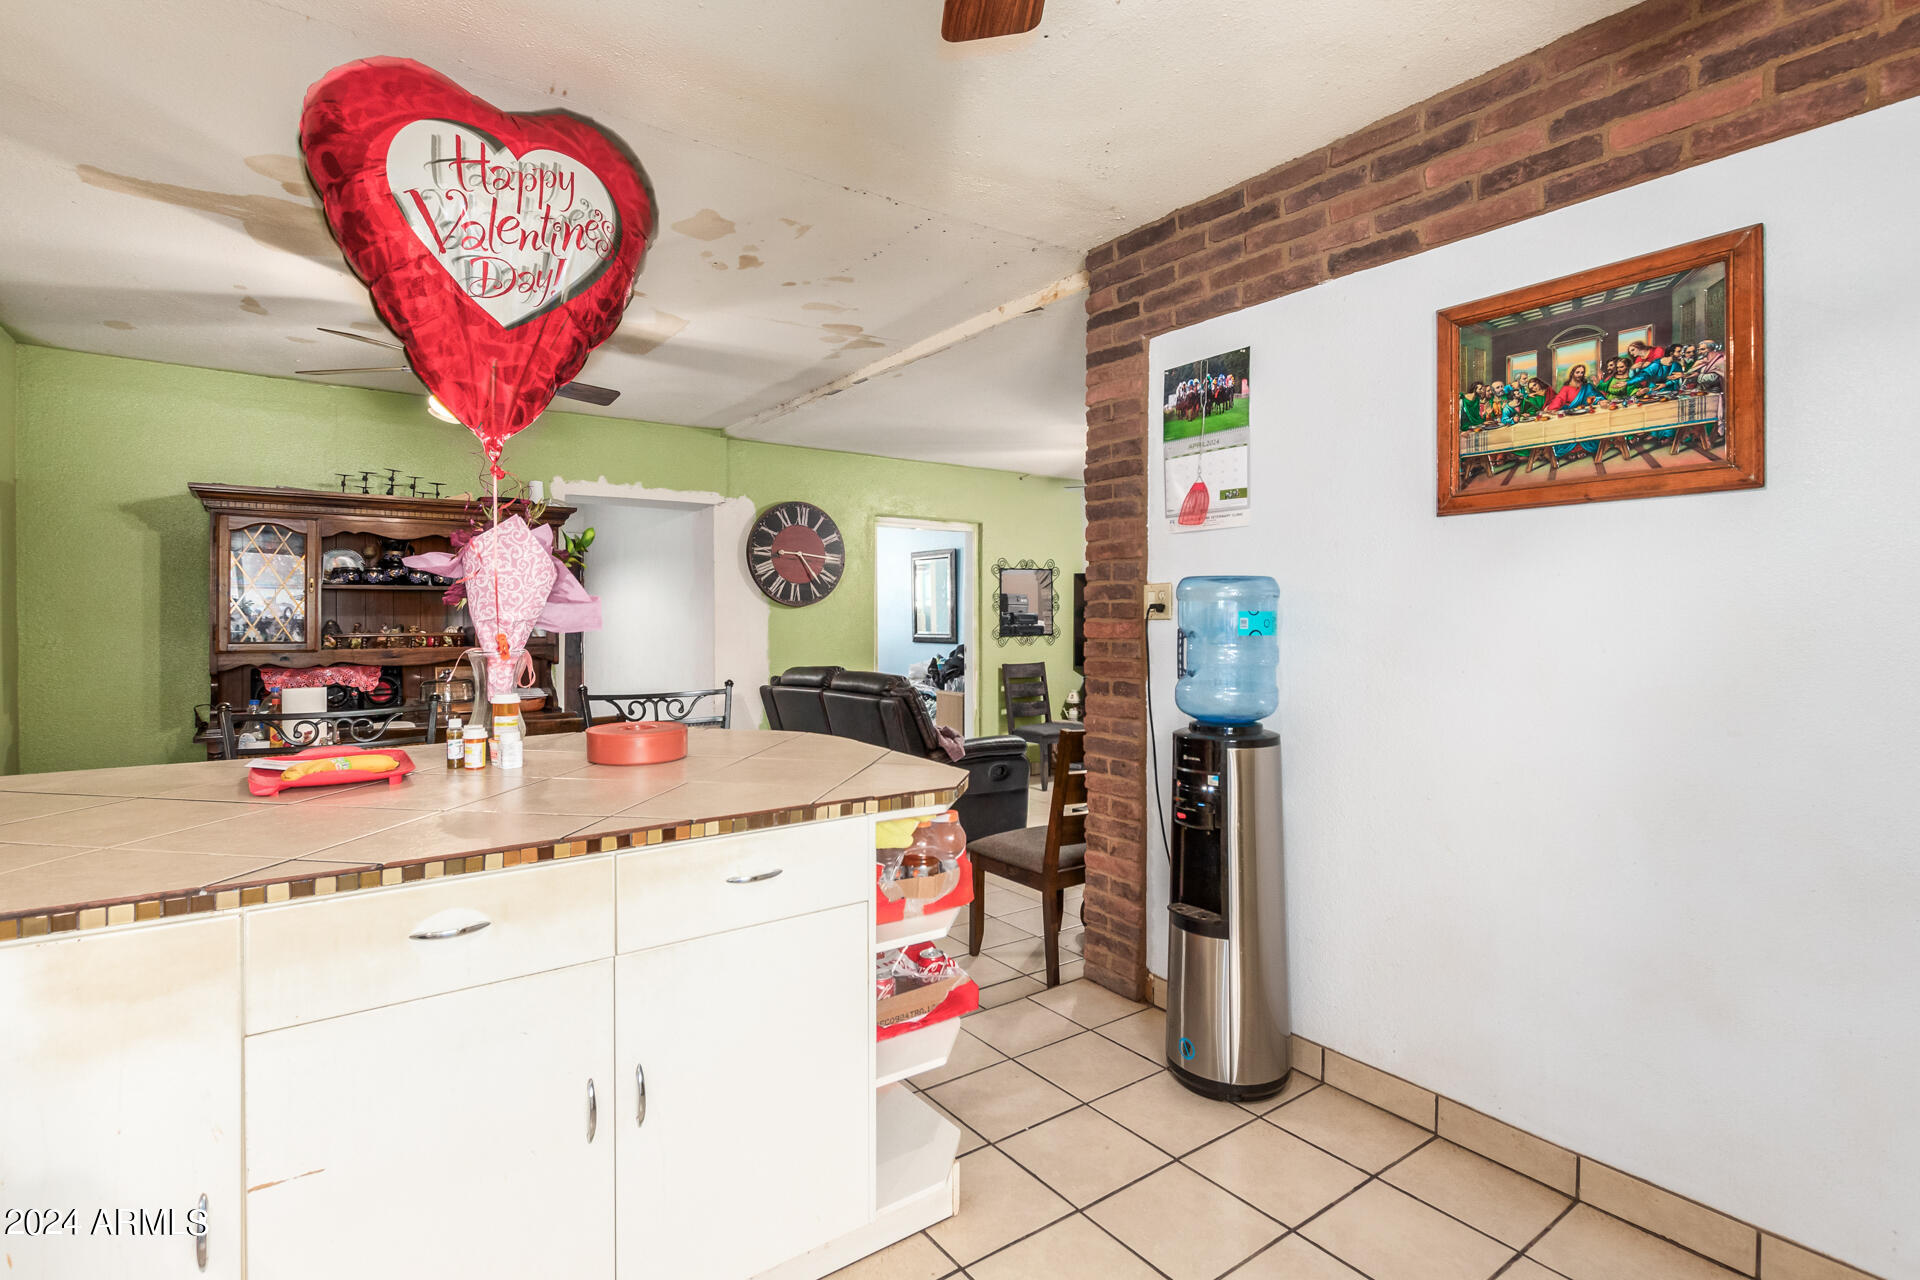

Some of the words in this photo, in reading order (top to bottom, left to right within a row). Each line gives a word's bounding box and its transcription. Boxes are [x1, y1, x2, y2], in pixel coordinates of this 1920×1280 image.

[449, 133, 575, 215] Happy
[403, 189, 616, 261] Valentine's
[468, 257, 567, 308] Day!
